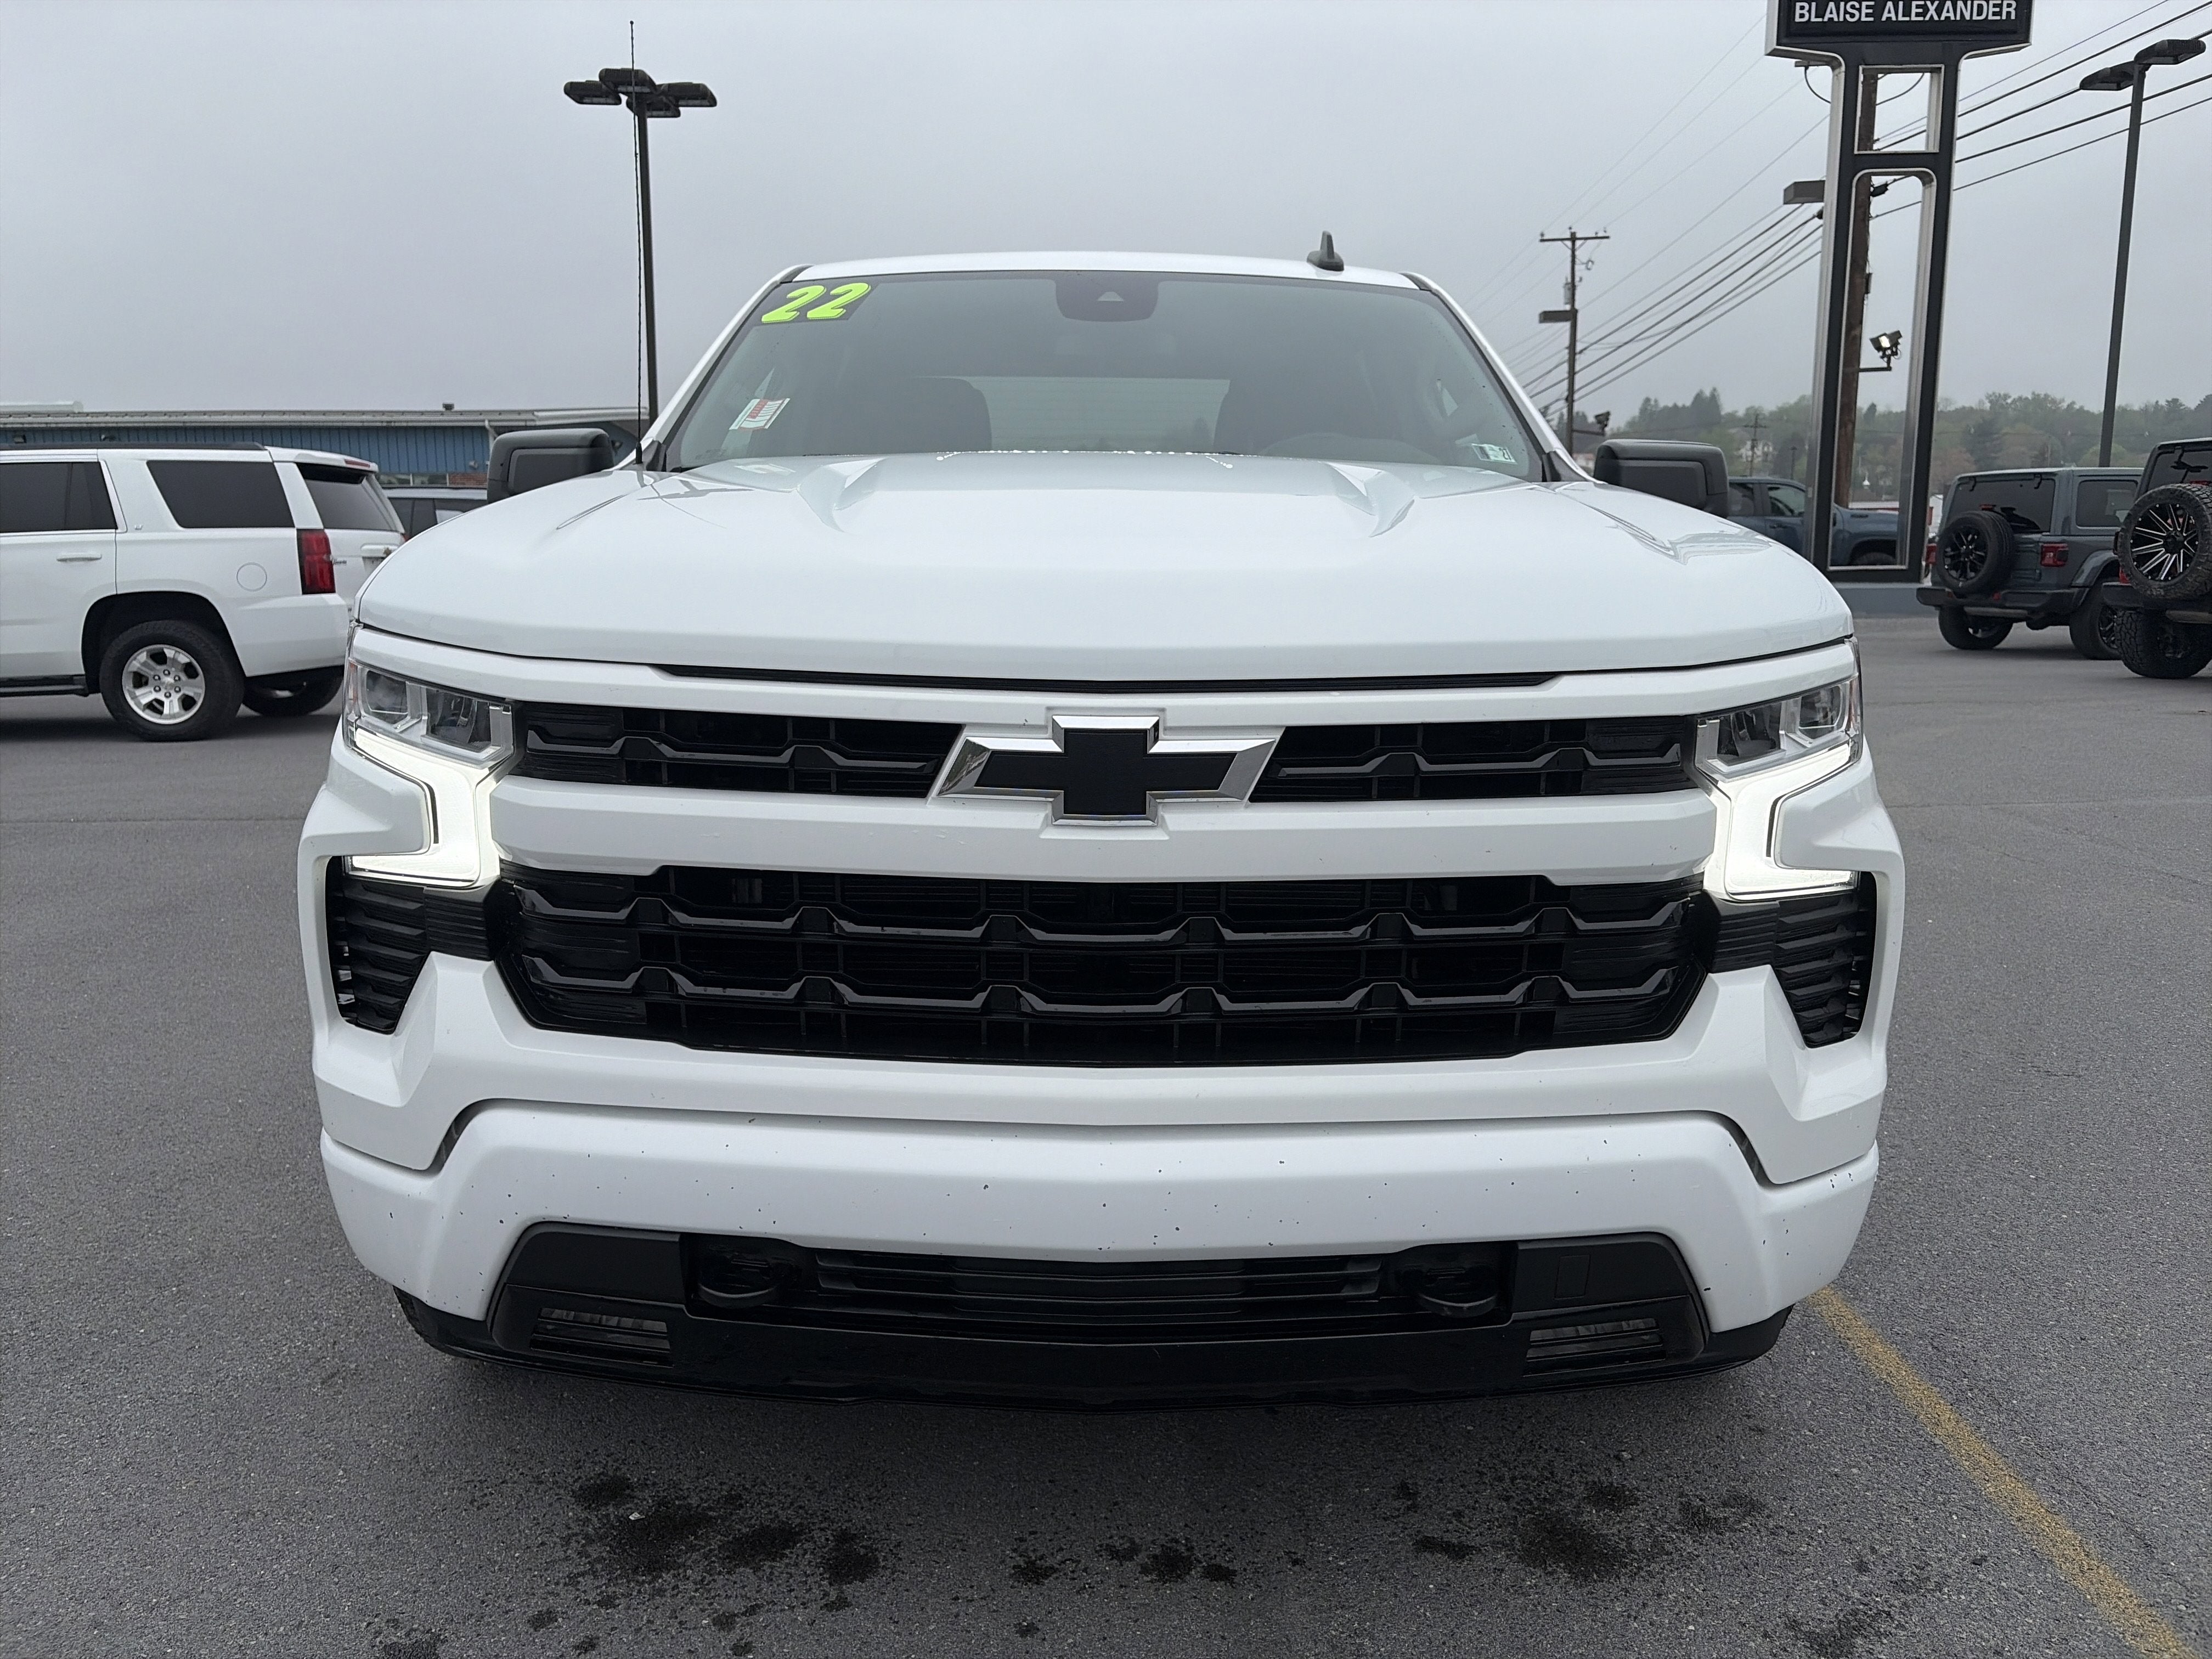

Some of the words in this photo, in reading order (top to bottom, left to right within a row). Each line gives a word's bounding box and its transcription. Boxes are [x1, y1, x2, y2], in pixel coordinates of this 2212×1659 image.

[1794, 1, 1875, 22] BLAISE
[1881, 0, 2017, 21] ALEXANDER
[761, 283, 871, 323] 22
